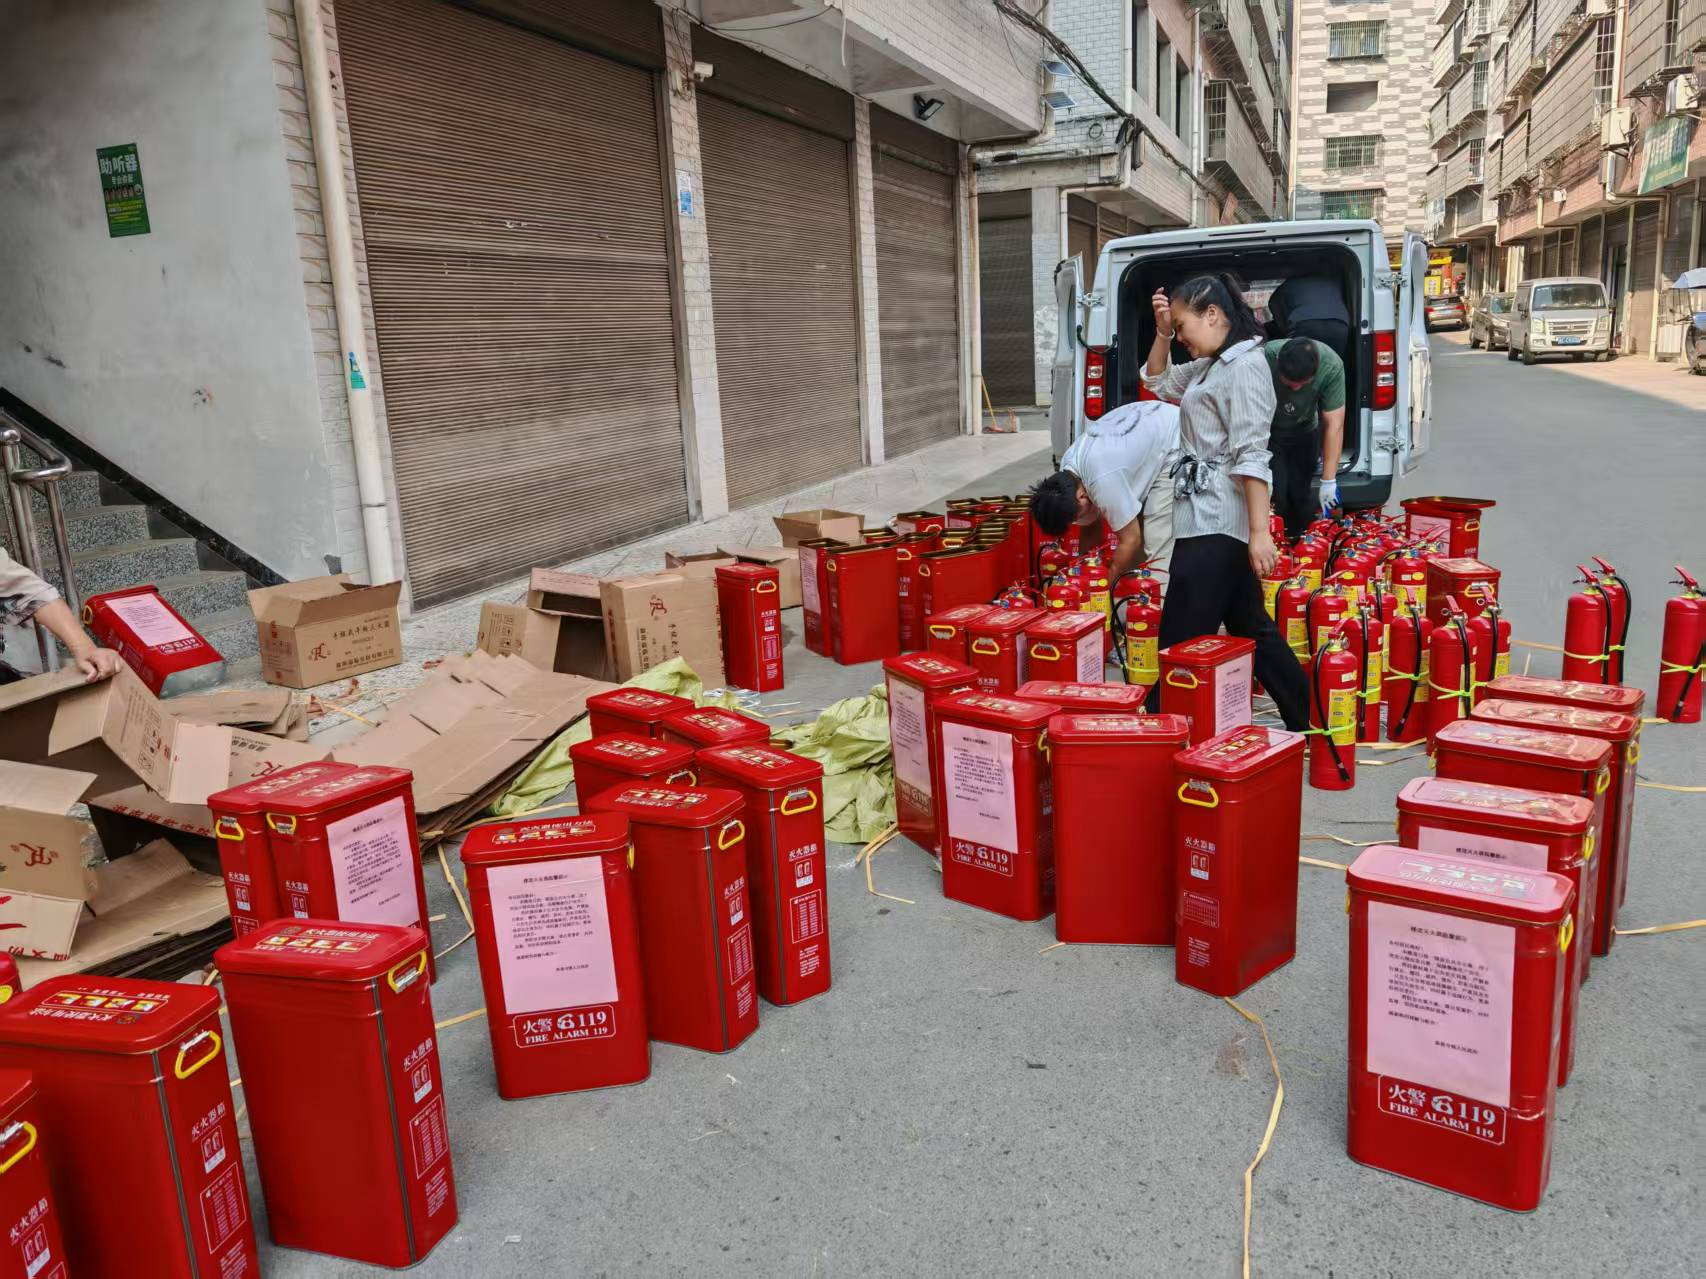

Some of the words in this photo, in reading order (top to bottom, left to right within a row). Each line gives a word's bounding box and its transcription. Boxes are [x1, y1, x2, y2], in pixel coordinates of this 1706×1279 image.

[100, 154, 137, 175] 助听器
[990, 851, 1009, 864] 119
[522, 1017, 552, 1036] 火警
[578, 1011, 608, 1028] 119
[525, 1033, 550, 1045] FIRE
[553, 1029, 589, 1041] ALARM
[593, 1027, 608, 1036] 119
[1388, 1084, 1427, 1108] 火警
[1458, 1102, 1496, 1126] 119
[1389, 1101, 1419, 1117] FIRE
[1423, 1111, 1470, 1132] ALARM
[1475, 1127, 1495, 1139] 119
